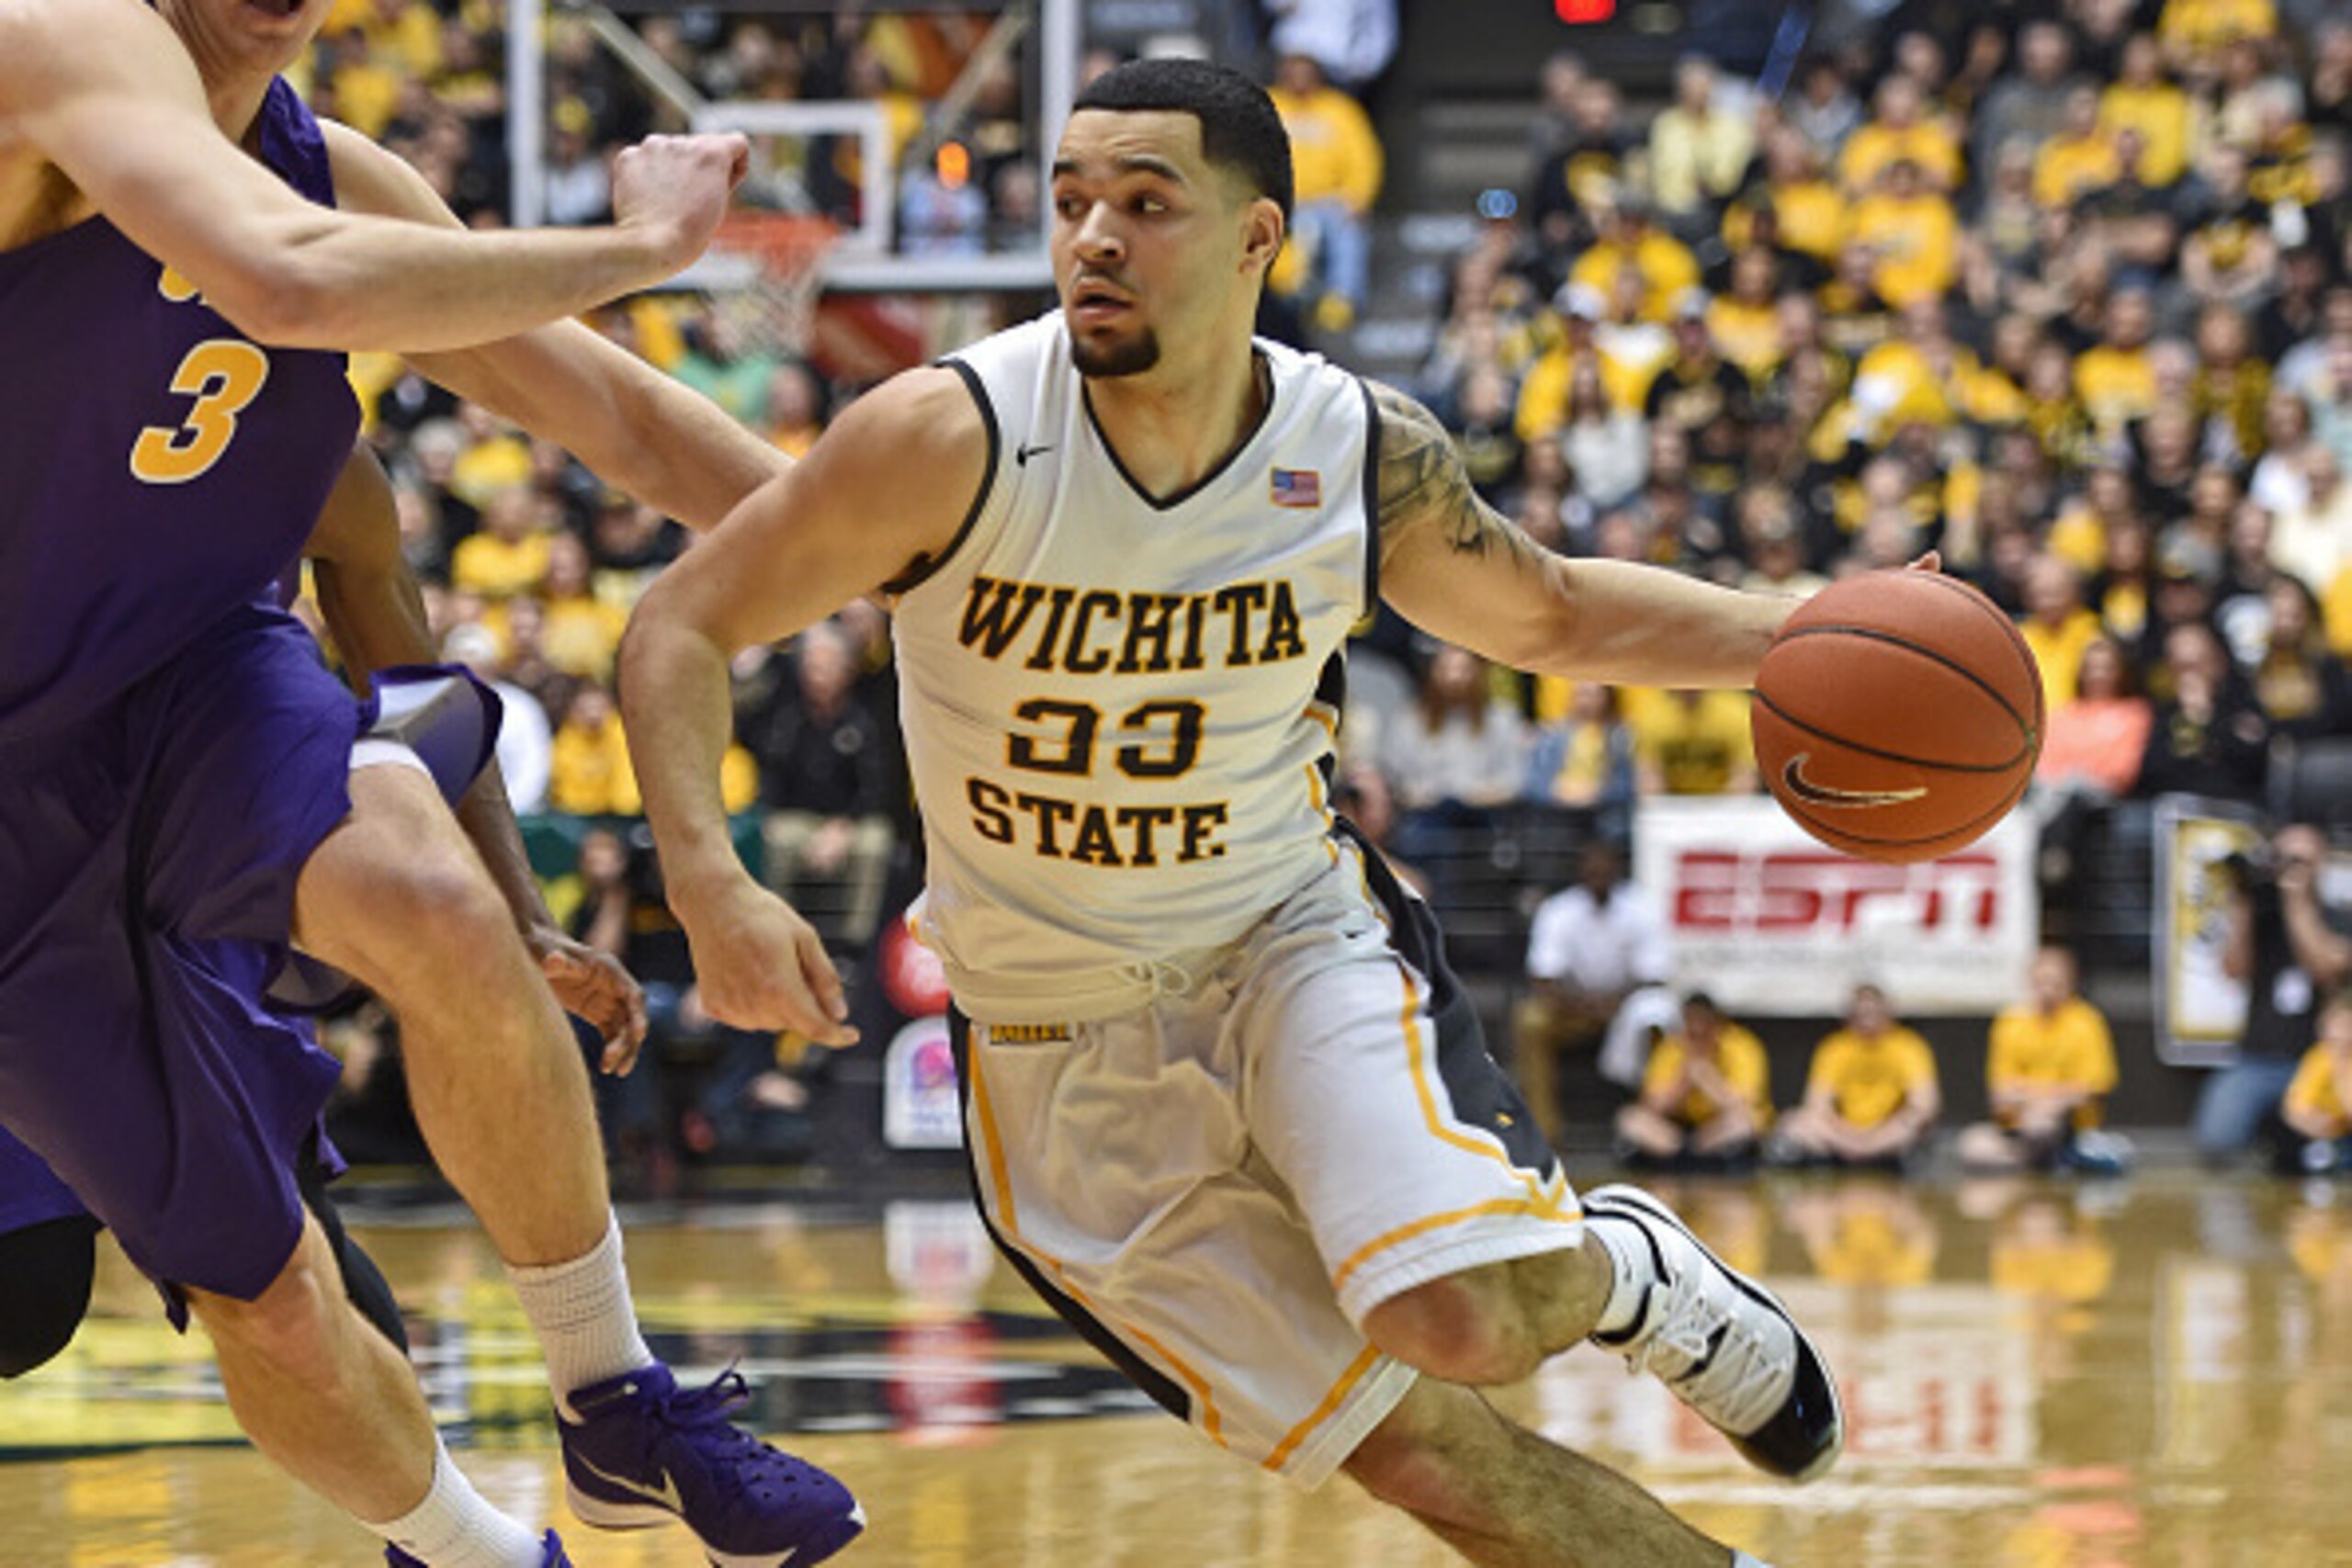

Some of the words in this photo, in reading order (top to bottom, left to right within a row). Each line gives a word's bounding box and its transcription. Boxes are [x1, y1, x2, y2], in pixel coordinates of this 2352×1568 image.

[130, 338, 270, 483] 3
[958, 575, 1306, 674] WICHITA
[966, 777, 1229, 865] STATE
[1673, 852, 1996, 931] ESPN
